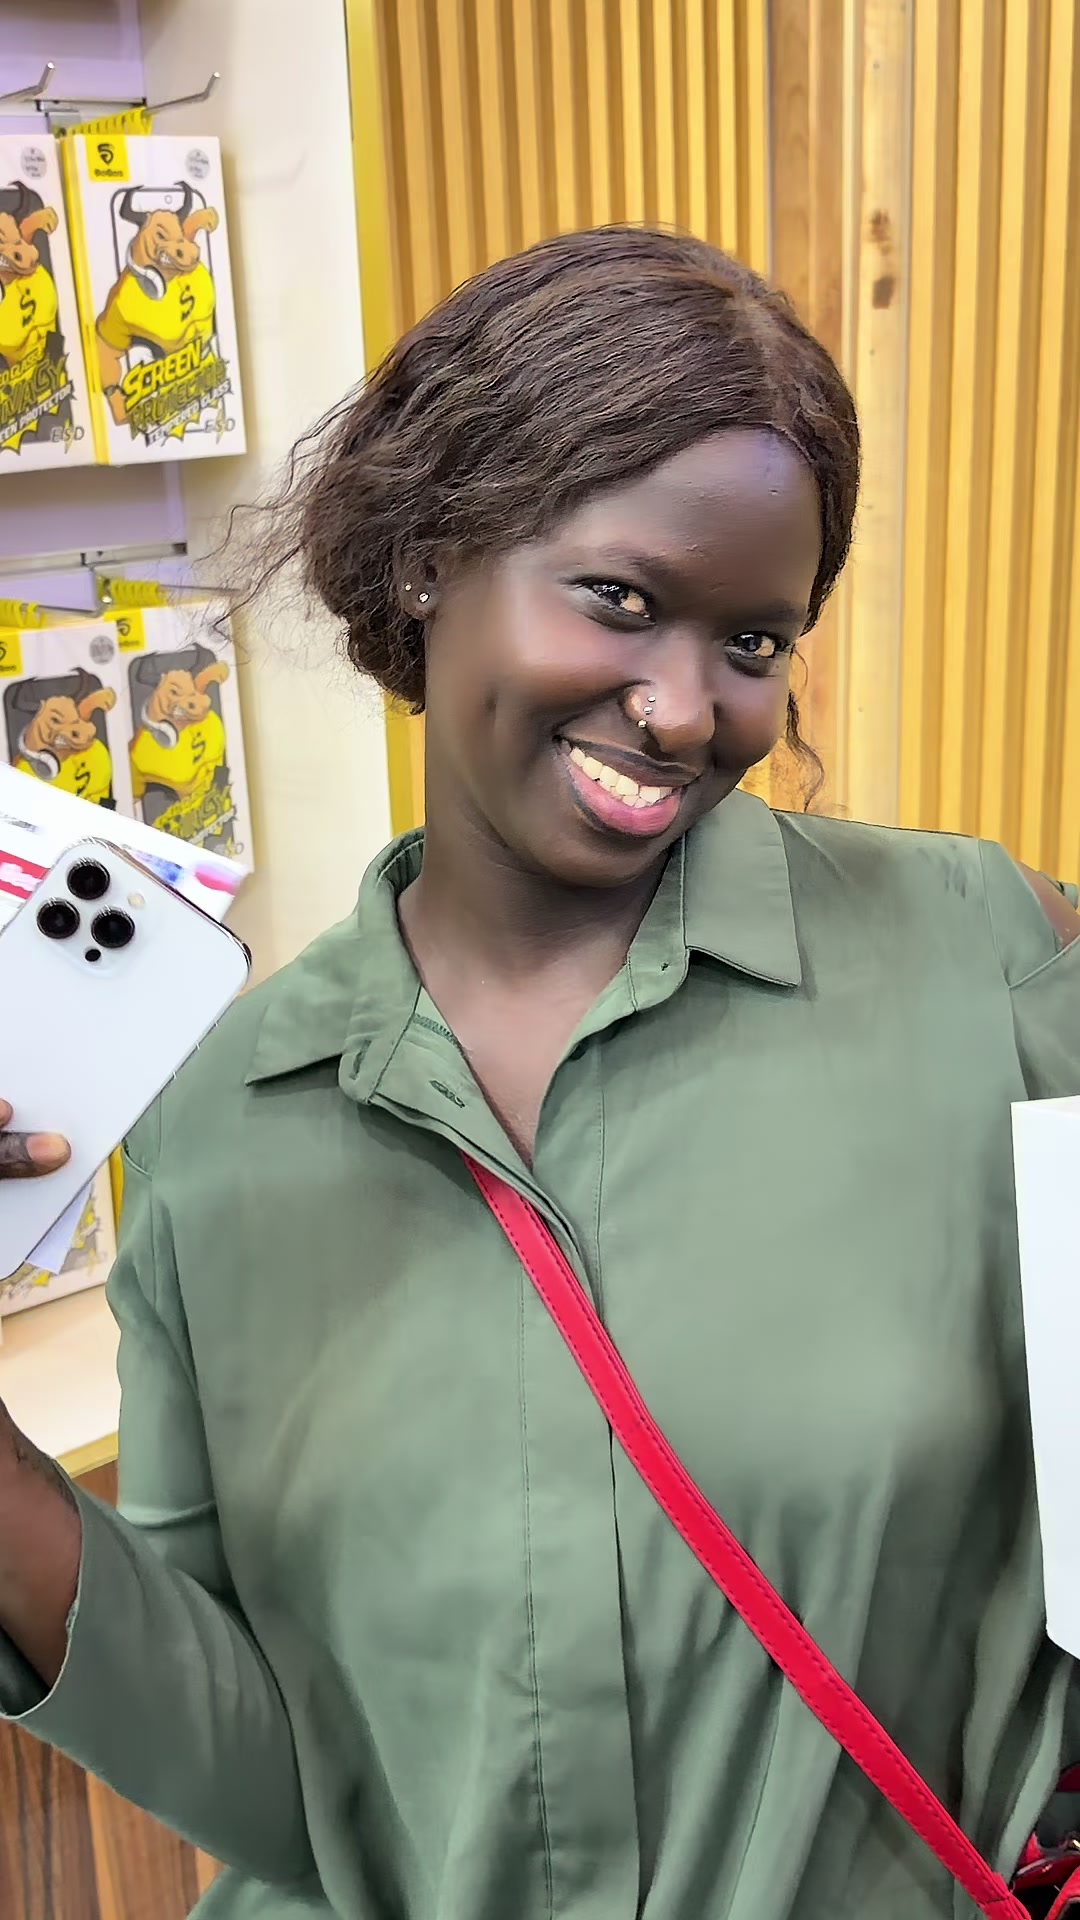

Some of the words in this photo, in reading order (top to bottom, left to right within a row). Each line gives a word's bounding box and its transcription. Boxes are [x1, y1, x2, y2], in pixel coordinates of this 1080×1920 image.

[121, 338, 203, 412] SCREEN
[204, 417, 236, 434] ESD
[51, 426, 85, 443] ESD
